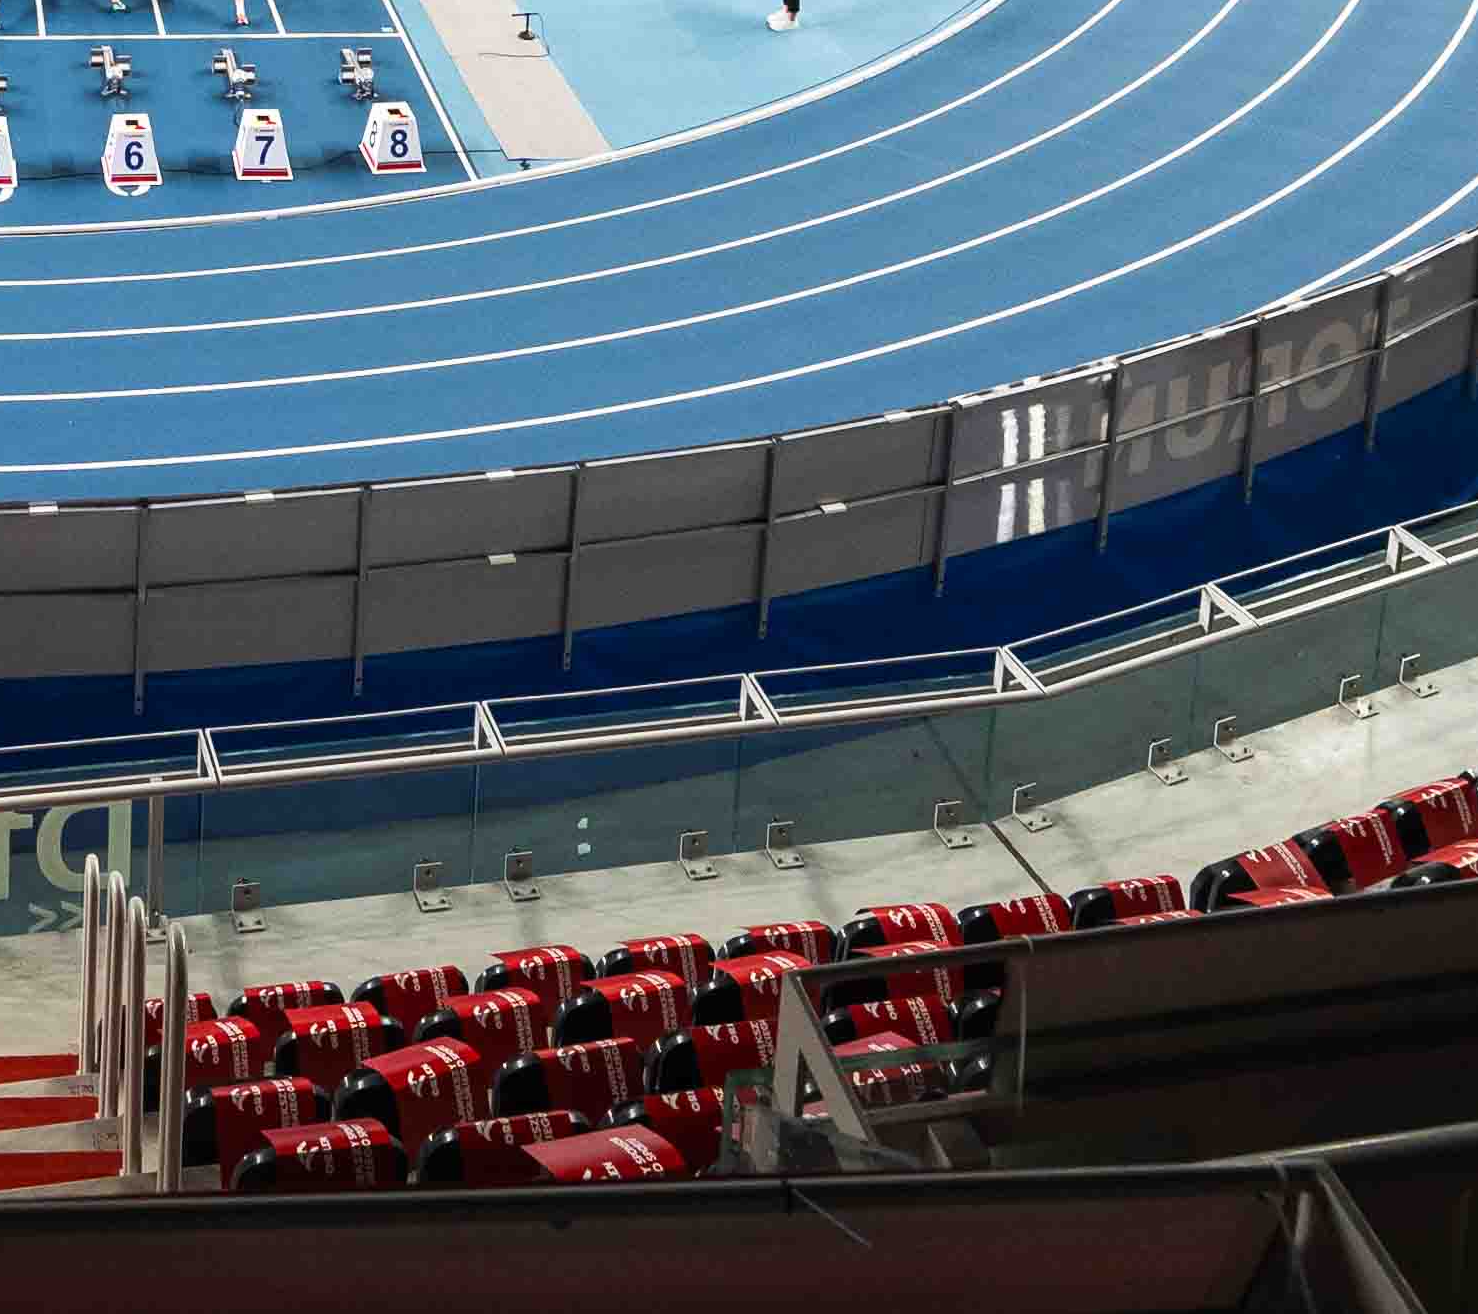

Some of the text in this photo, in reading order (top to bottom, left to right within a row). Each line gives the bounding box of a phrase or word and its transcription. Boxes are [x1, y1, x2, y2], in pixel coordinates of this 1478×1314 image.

[123, 141, 144, 171] 6
[254, 135, 275, 165] 7
[390, 129, 410, 159] 8
